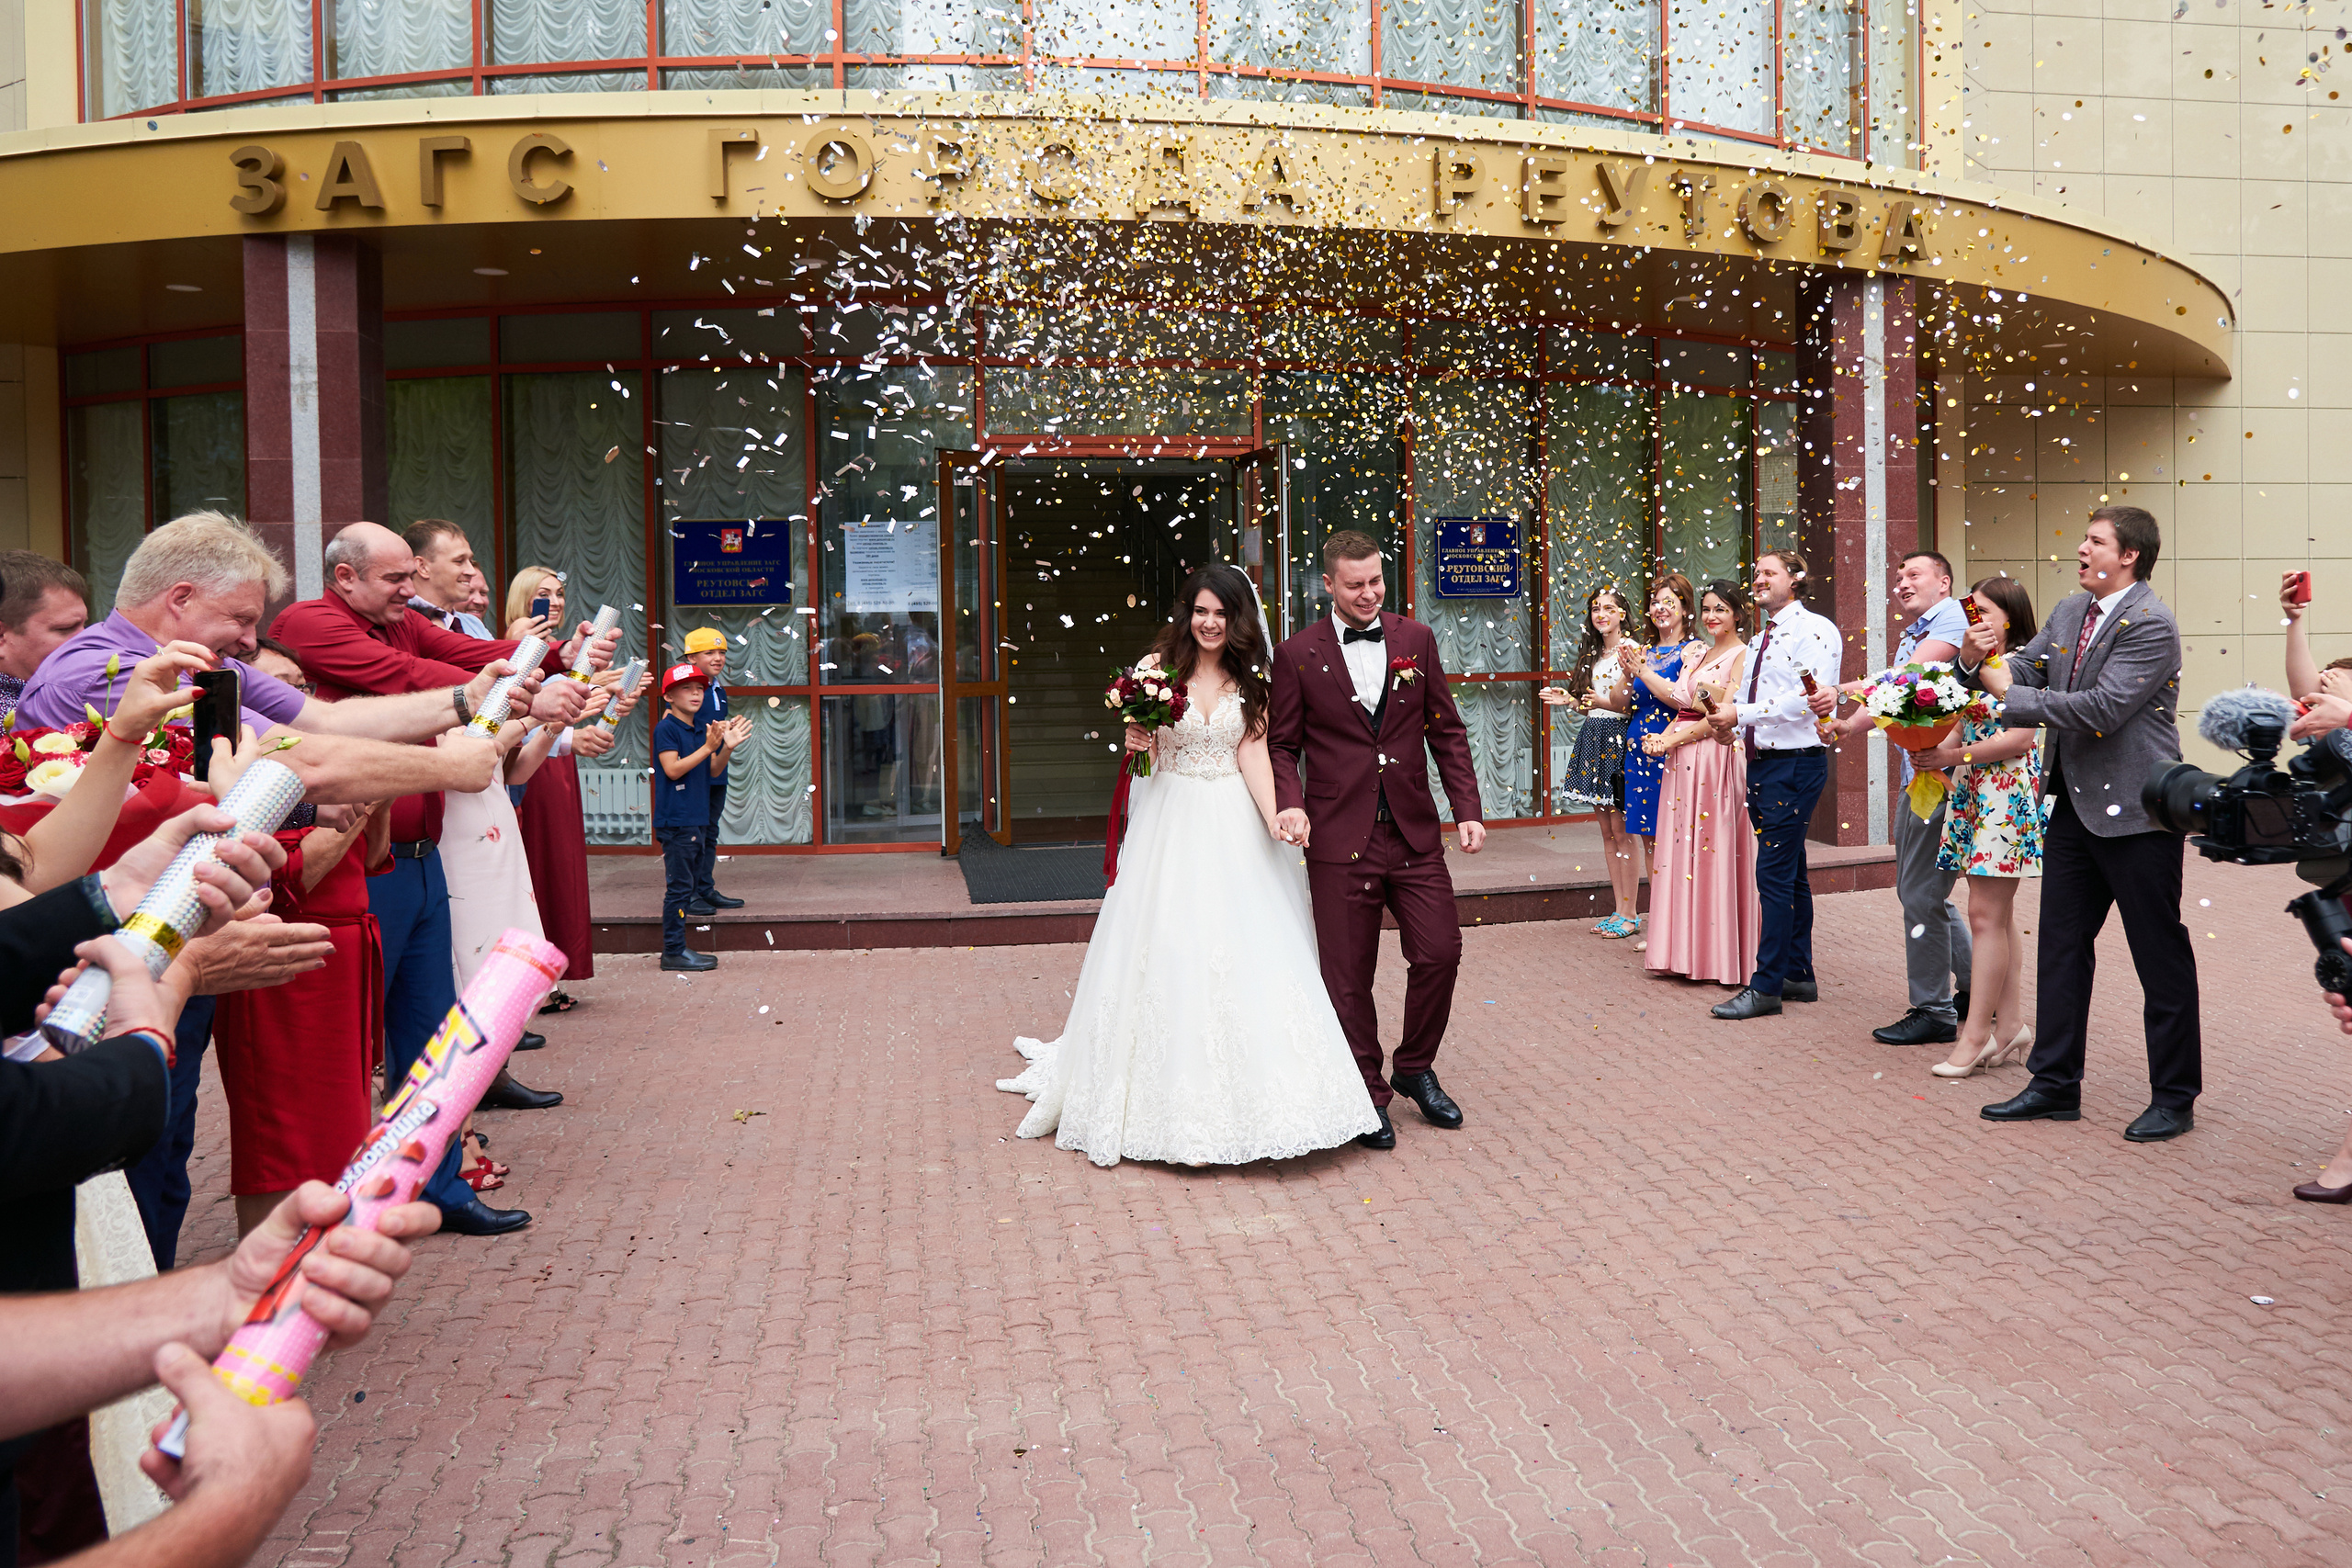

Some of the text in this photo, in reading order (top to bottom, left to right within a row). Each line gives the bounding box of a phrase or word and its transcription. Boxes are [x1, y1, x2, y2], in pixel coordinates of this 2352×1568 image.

[229, 127, 1930, 263] ЗАГС ГОРОДА РЕУТОВА
[700, 589, 766, 598] ОТДЕЛ ЗАГС
[1451, 574, 1507, 583] ОТДЕЛ ЗАГС
[334, 1099, 439, 1195] охлопушка
